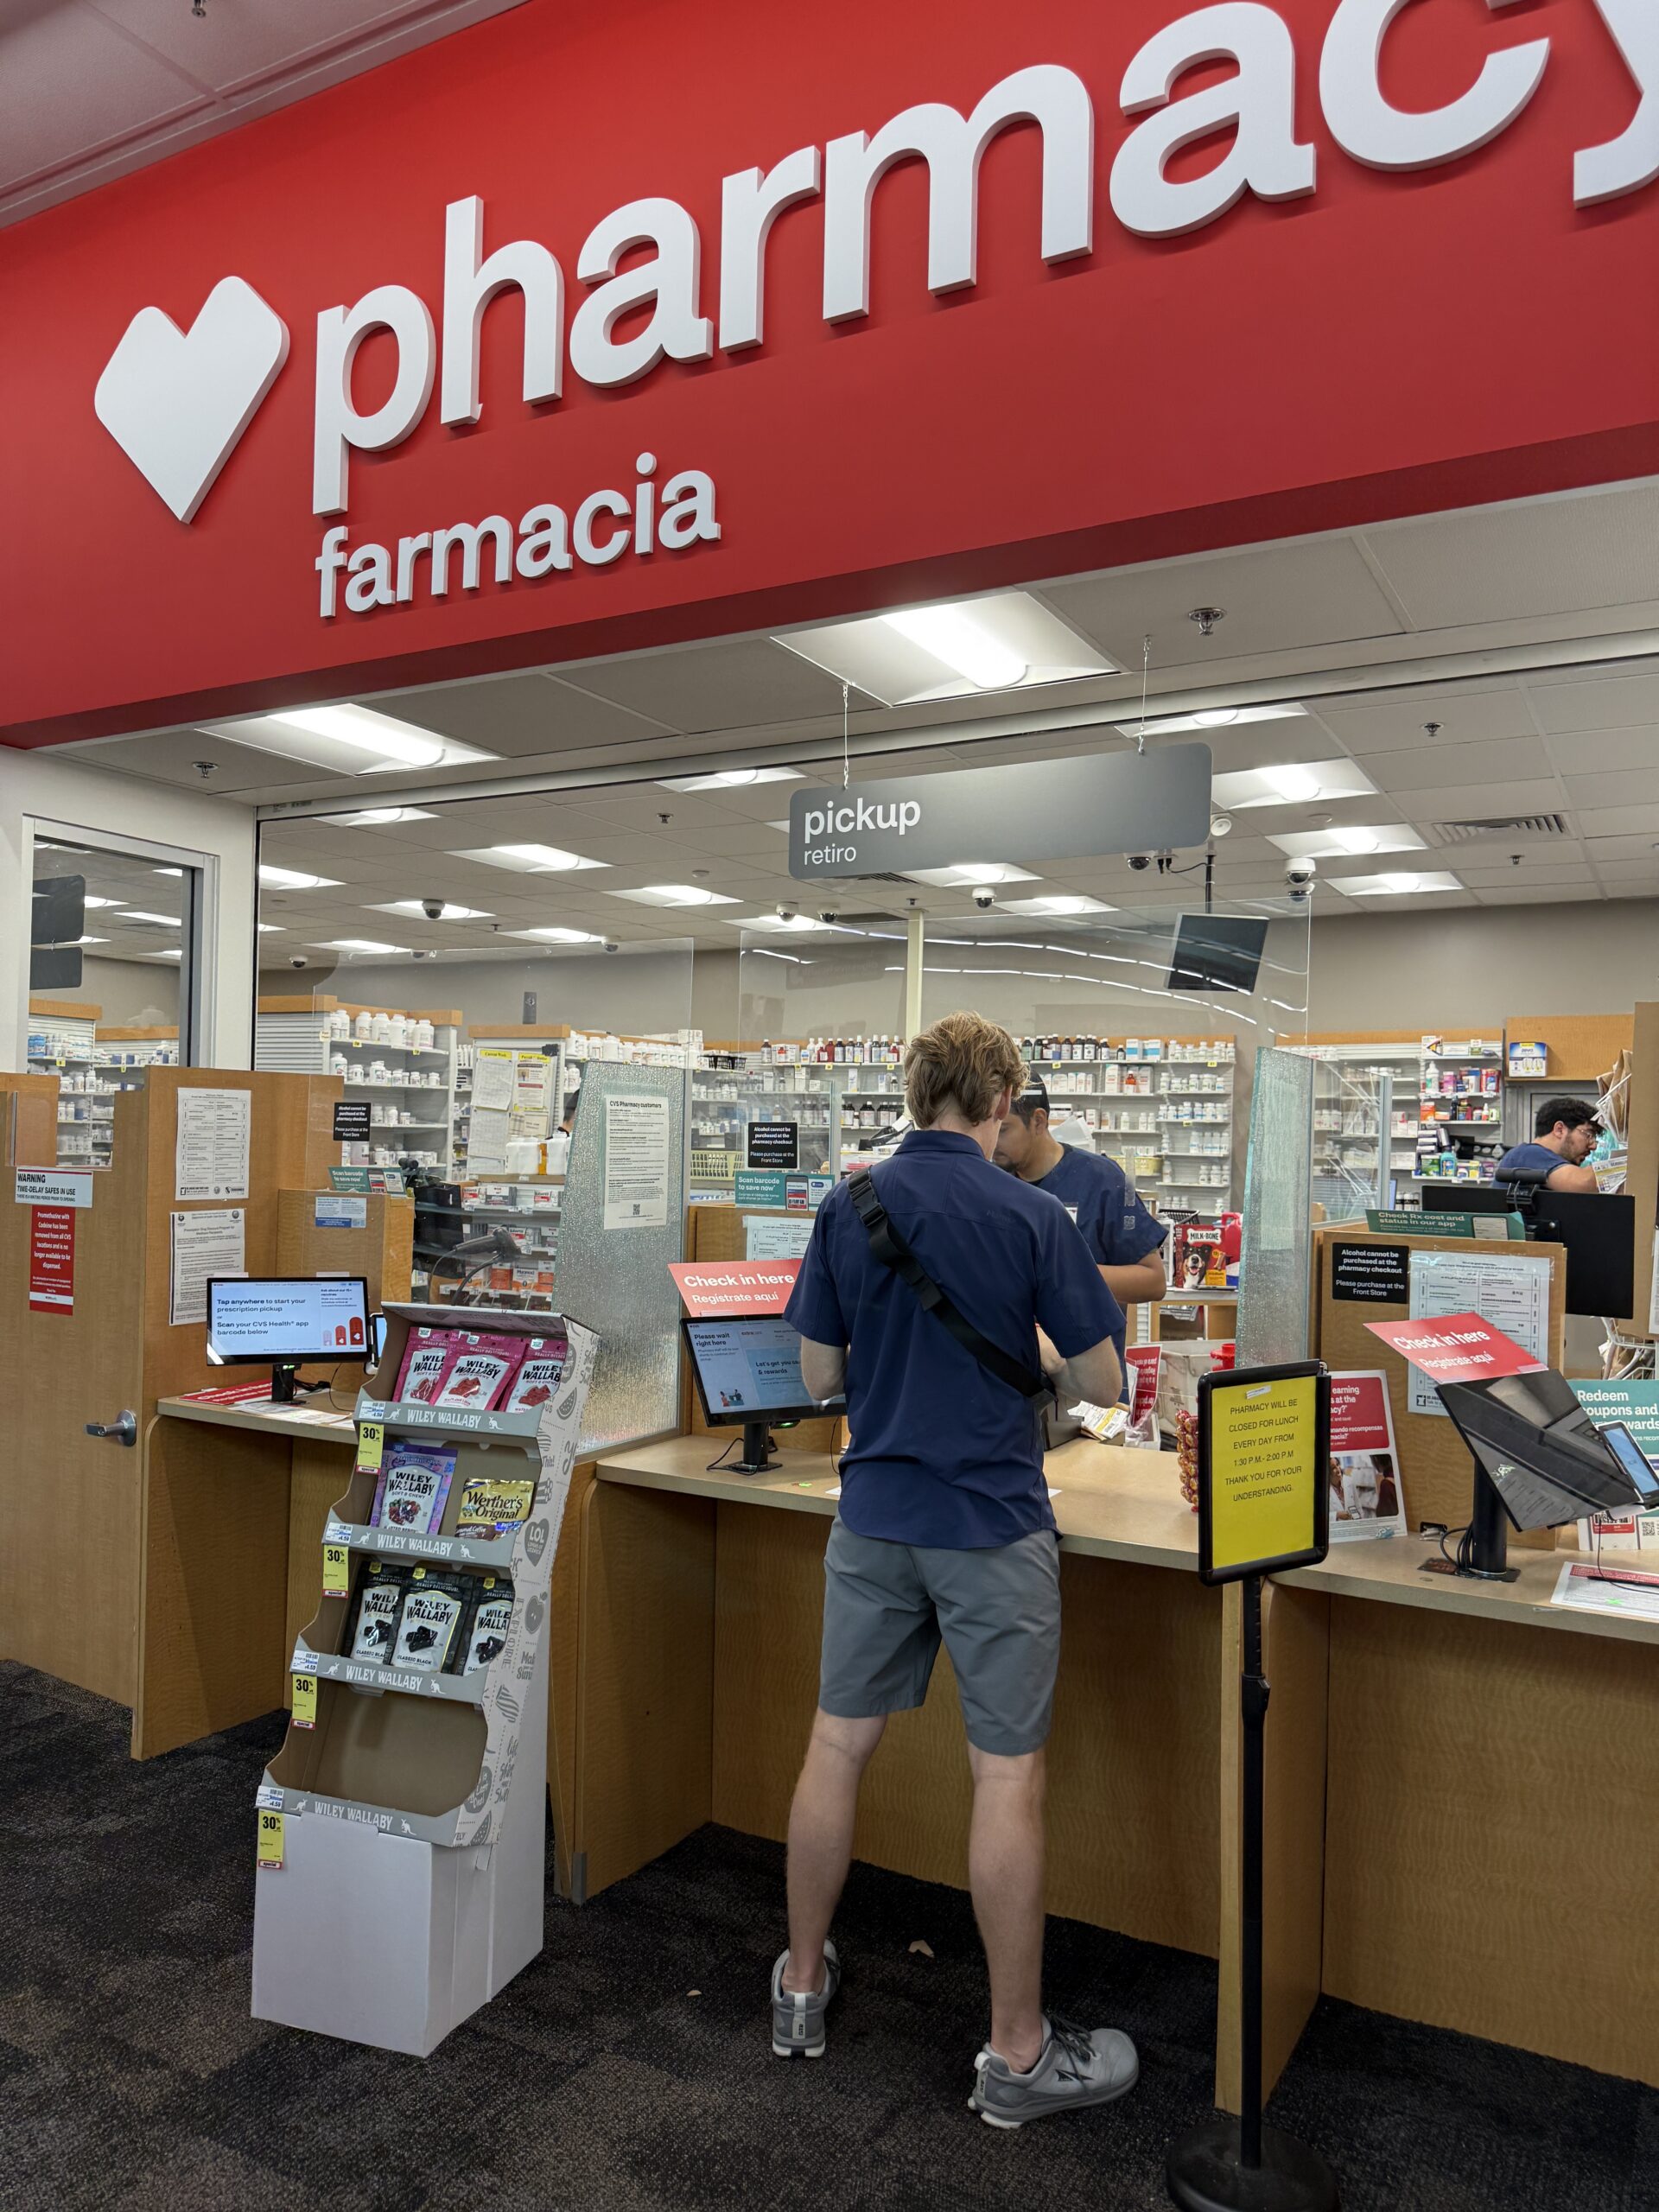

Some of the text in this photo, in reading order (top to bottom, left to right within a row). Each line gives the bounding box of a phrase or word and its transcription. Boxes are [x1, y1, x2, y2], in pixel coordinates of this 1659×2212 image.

[315, 452, 721, 618] farmacia
[804, 798, 921, 843] pickup
[804, 843, 857, 865] retiro
[17, 1173, 46, 1183] WARNING
[1338, 1265, 1370, 1274] pharmacy
[684, 1274, 795, 1287] Check in here
[1357, 1281, 1386, 1290] purchase
[1394, 1334, 1438, 1350] Check
[1452, 1329, 1491, 1344] here
[467, 1360, 499, 1370] WILEY
[455, 1366, 501, 1379] WALLABY
[522, 1370, 561, 1382] WALLAB
[1332, 1385, 1359, 1395] earning
[1577, 1389, 1629, 1402] Redeem
[1230, 1402, 1269, 1414] PHARMACY
[1271, 1401, 1287, 1409] WILL
[1635, 1403, 1657, 1414] and
[407, 1408, 481, 1429] WILEY WALLABY
[1229, 1415, 1298, 1433] CLOSED FOR LUNCH
[363, 1427, 375, 1440] 30
[1234, 1433, 1294, 1450] EVERY DAY FROM
[1234, 1458, 1247, 1466] 1:30
[1267, 1452, 1280, 1462] 2:00
[396, 1471, 432, 1484] WILEY
[1225, 1466, 1302, 1485] THANK YOU FOR YOUR
[389, 1479, 435, 1496] WALLABY
[467, 1491, 523, 1509] Werther's
[475, 1506, 519, 1521] Original
[531, 1526, 544, 1543] LOL
[377, 1534, 454, 1557] WILEY WALLABY
[327, 1550, 340, 1561] 30
[415, 1599, 451, 1611] WILEY
[407, 1605, 453, 1624] WALLABY
[486, 1609, 511, 1619] WILE
[478, 1617, 506, 1630] WALLA
[346, 1665, 423, 1691] WILEY WALLABY
[296, 1679, 308, 1692] 30
[263, 1816, 276, 1829] 30
[315, 1802, 393, 1830] WILEY WALLABY
